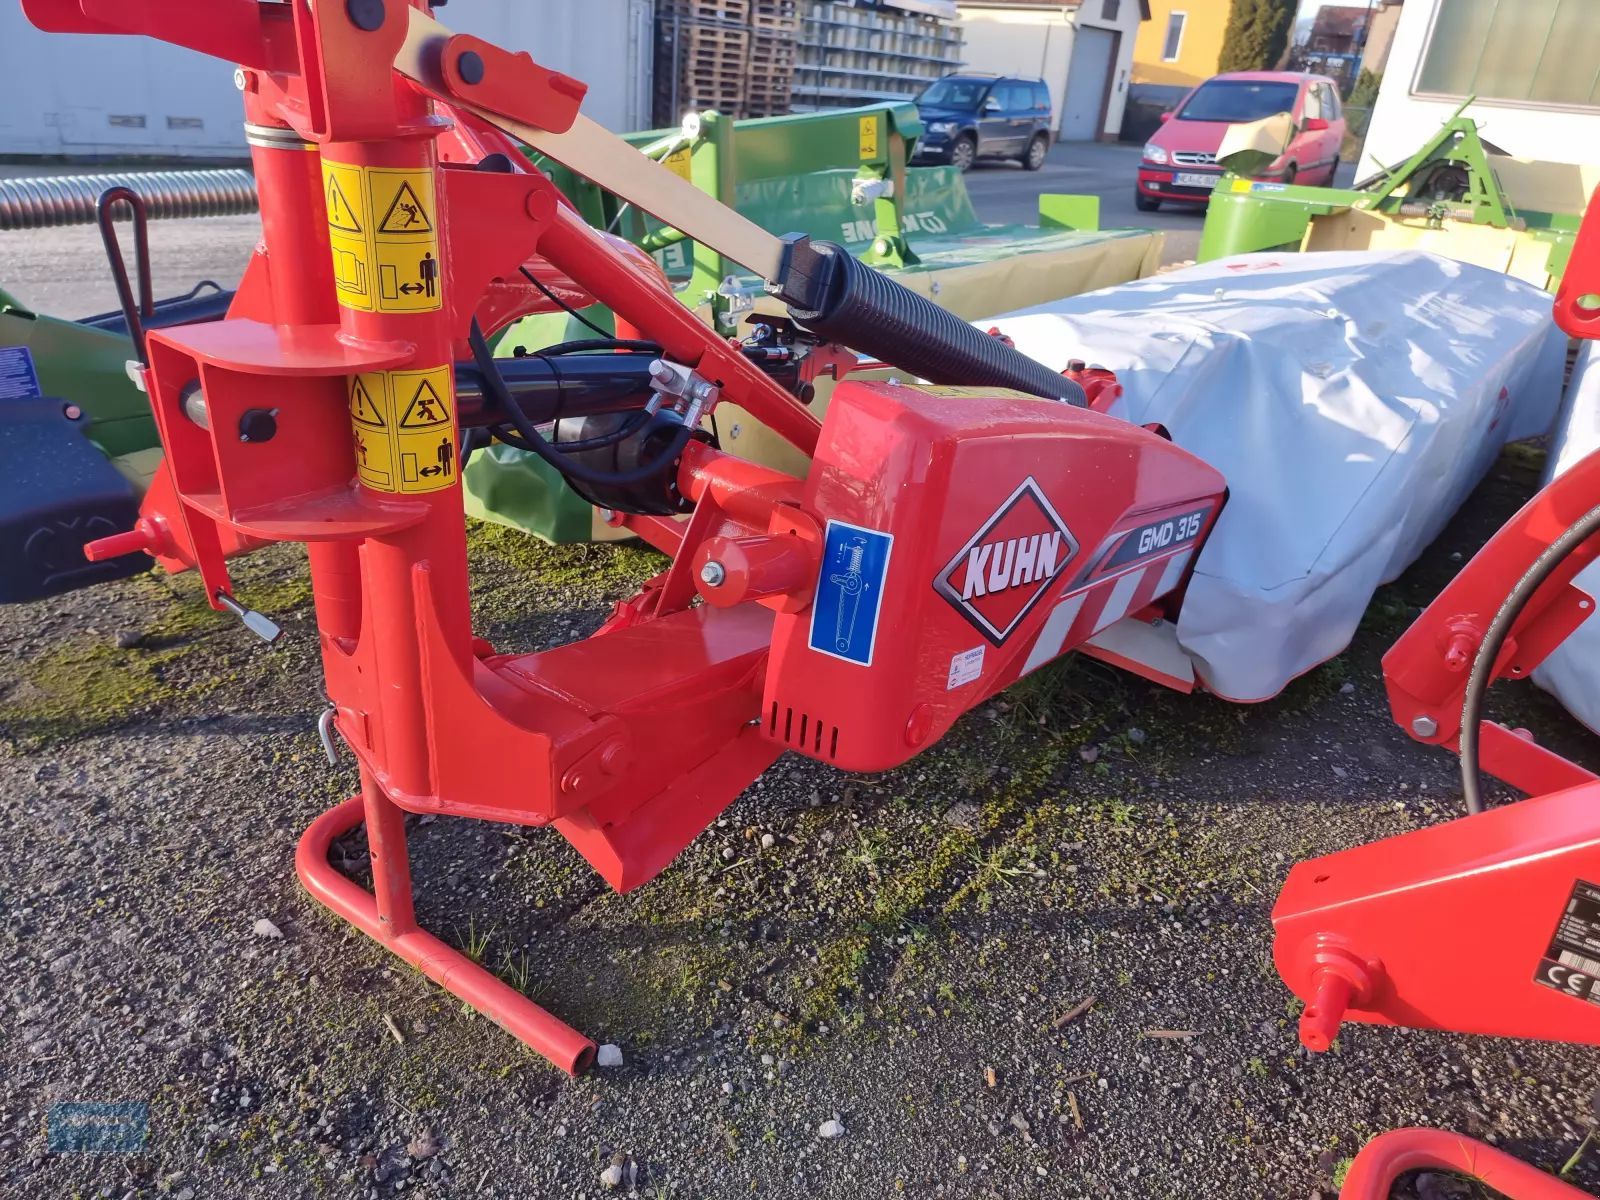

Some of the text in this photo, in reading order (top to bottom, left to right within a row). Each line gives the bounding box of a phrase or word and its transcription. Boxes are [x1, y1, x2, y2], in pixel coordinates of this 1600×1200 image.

[1138, 513, 1202, 555] GMD 315
[961, 530, 1061, 602] KUHN
